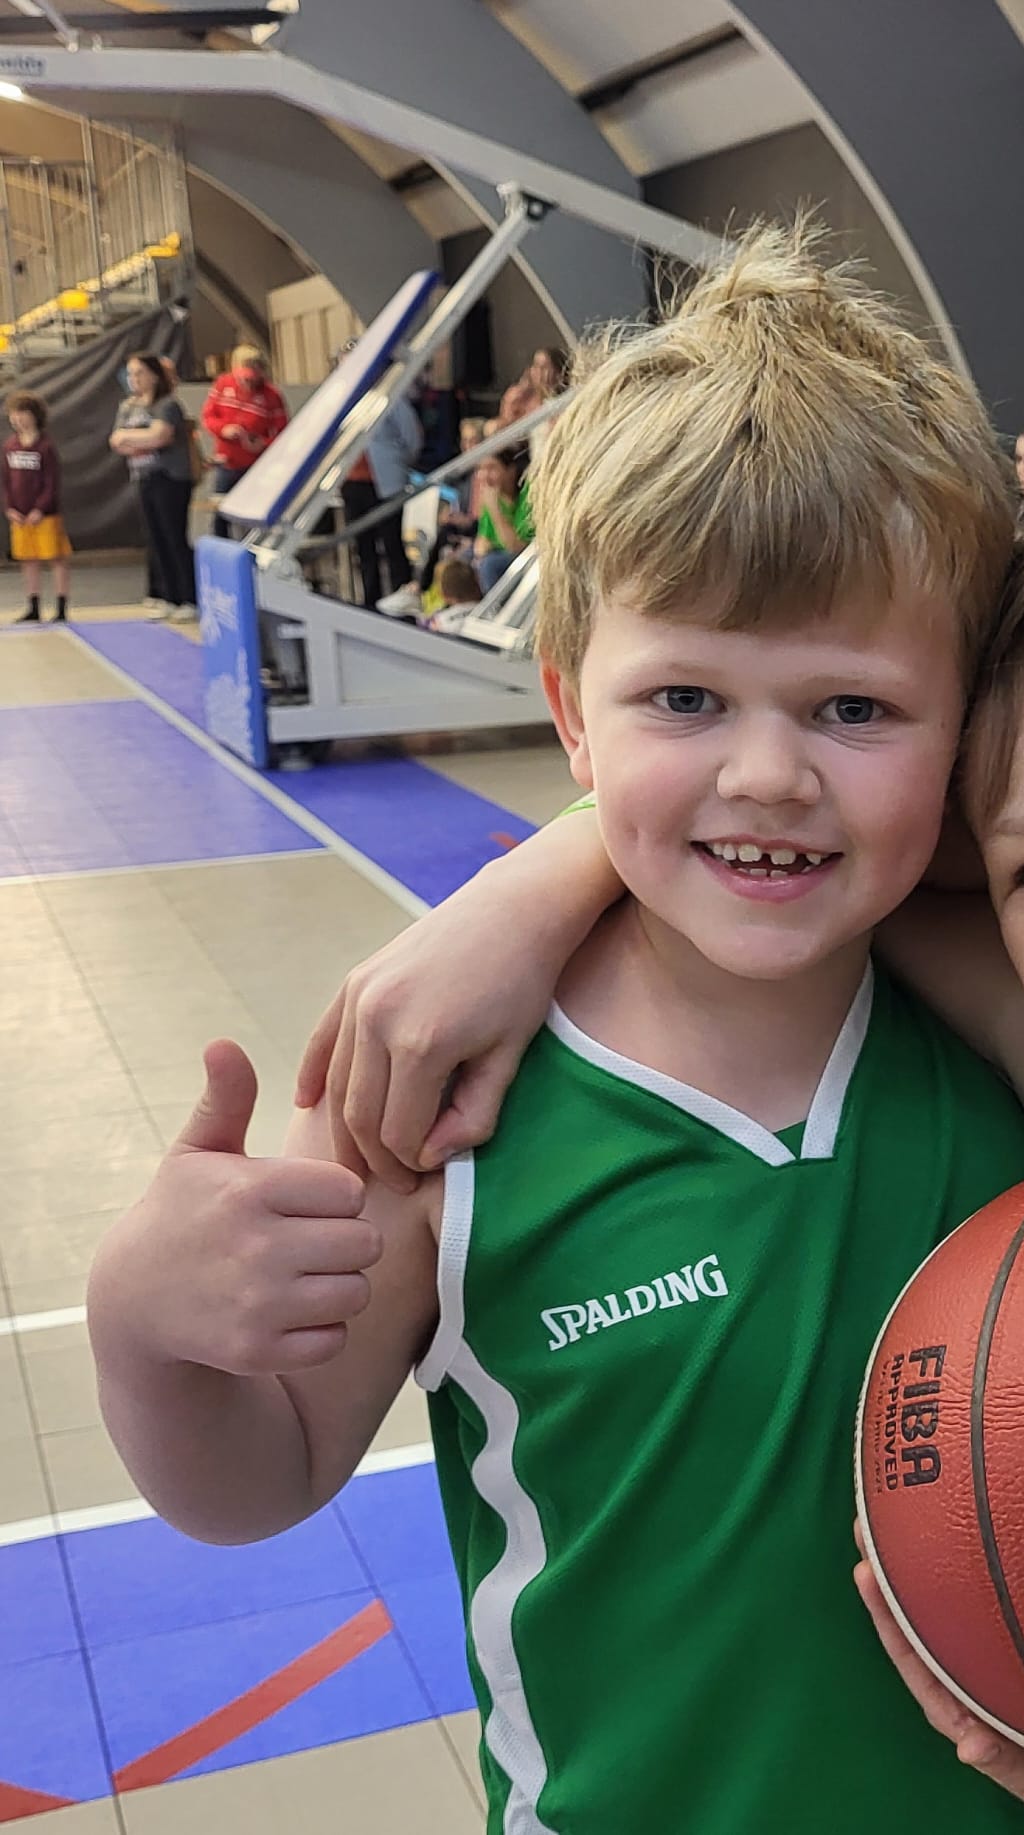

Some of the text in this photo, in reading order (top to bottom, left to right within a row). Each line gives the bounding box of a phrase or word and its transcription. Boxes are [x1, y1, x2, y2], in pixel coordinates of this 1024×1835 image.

[540, 1253, 729, 1351] SPALDING
[884, 1353, 904, 1491] APPROVED
[901, 1344, 947, 1488] FIBA
